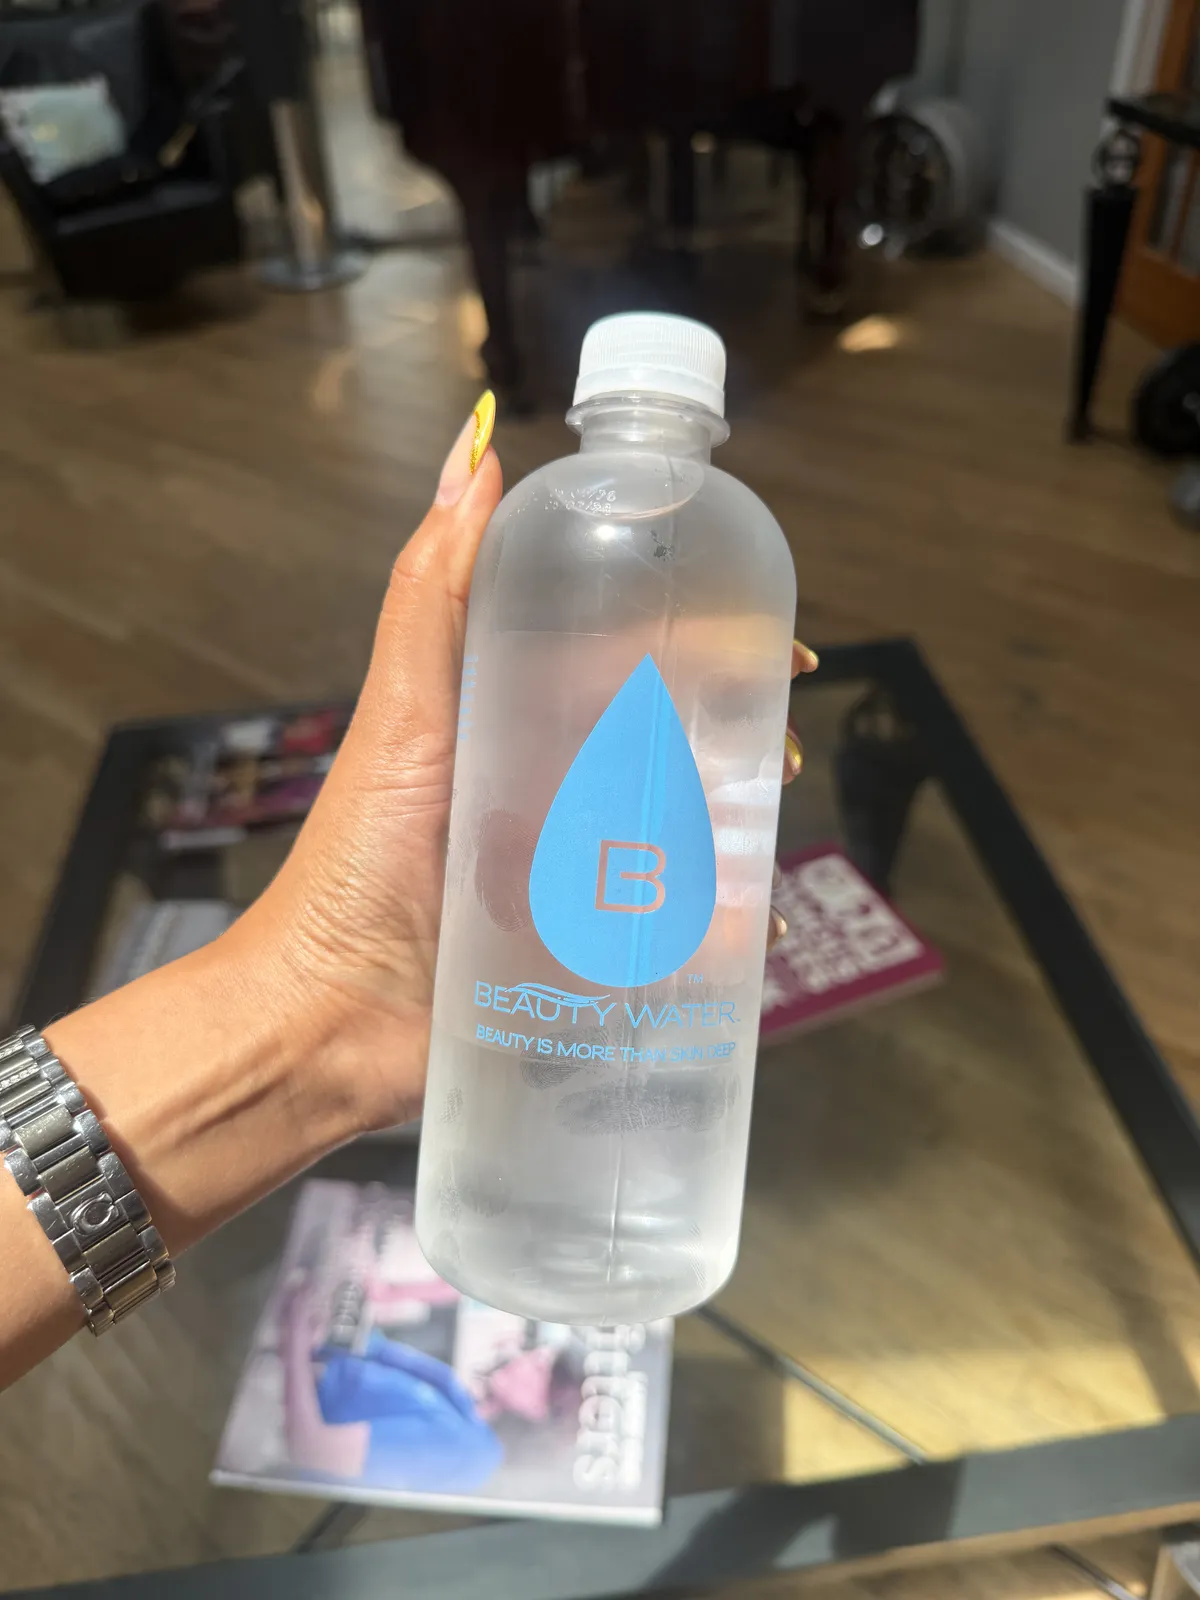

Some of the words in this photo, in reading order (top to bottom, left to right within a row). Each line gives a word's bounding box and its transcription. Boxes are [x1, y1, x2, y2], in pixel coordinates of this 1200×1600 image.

[595, 839, 666, 914] B
[687, 973, 703, 984] TM
[474, 980, 617, 1026] BEAUTY
[476, 1023, 535, 1051] BEAUTY
[537, 1037, 553, 1054] IS
[557, 1040, 616, 1061] MORE
[620, 1046, 666, 1062] THAN
[669, 1045, 704, 1062] SKIN
[707, 1041, 736, 1059] DEEP
